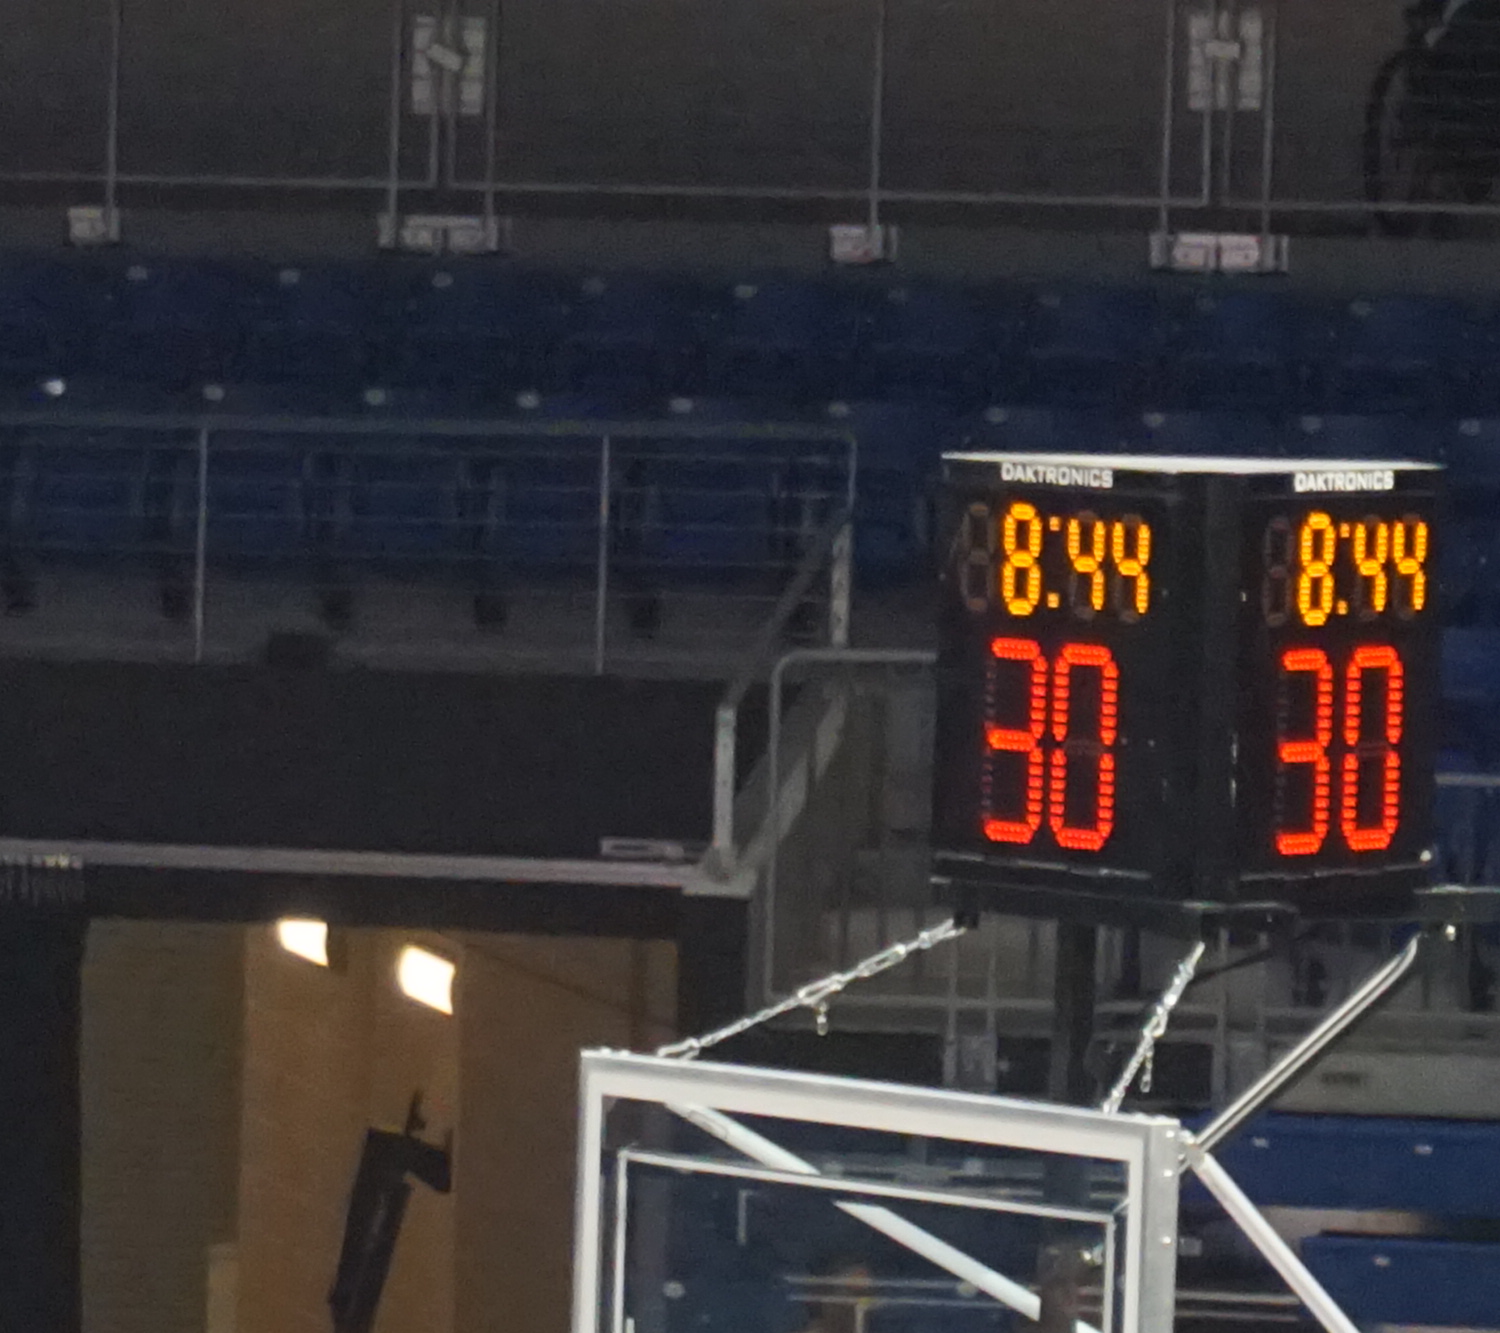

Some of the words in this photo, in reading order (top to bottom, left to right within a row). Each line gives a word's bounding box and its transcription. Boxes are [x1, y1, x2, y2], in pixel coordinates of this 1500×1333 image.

[1001, 462, 1114, 489] DAKTRONICS
[1294, 470, 1394, 492] DAKTRONICS
[1003, 502, 1152, 616] 8:44
[1299, 510, 1428, 627] 8:44
[983, 636, 1119, 852] 30
[1276, 645, 1404, 856] 30
